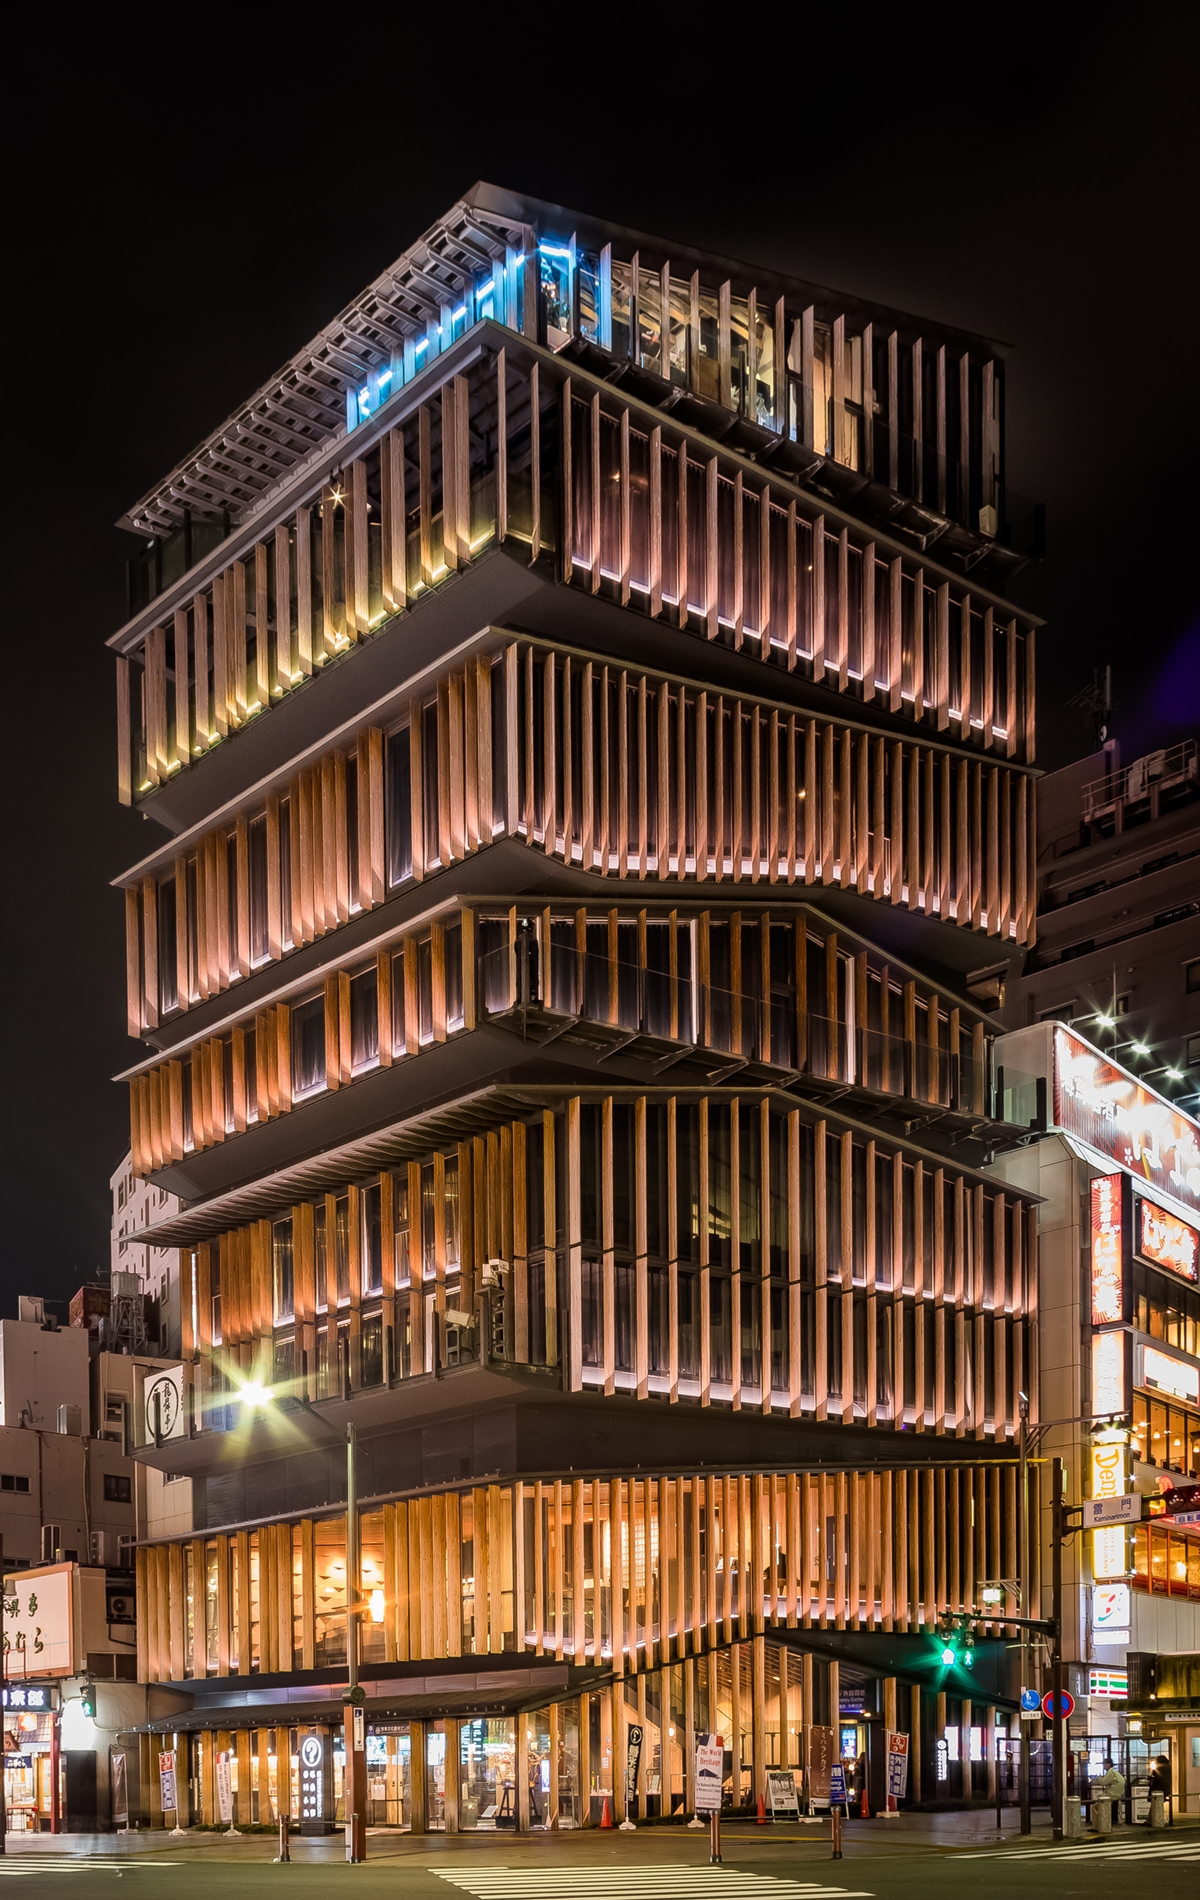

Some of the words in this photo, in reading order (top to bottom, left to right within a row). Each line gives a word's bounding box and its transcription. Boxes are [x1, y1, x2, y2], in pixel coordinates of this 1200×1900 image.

[1093, 1498, 1132, 1515] 雷門
[1094, 1512, 1131, 1523] Kaminarimon
[700, 1748, 709, 1756] The
[709, 1748, 722, 1757] World
[699, 1757, 721, 1767] Heritage
